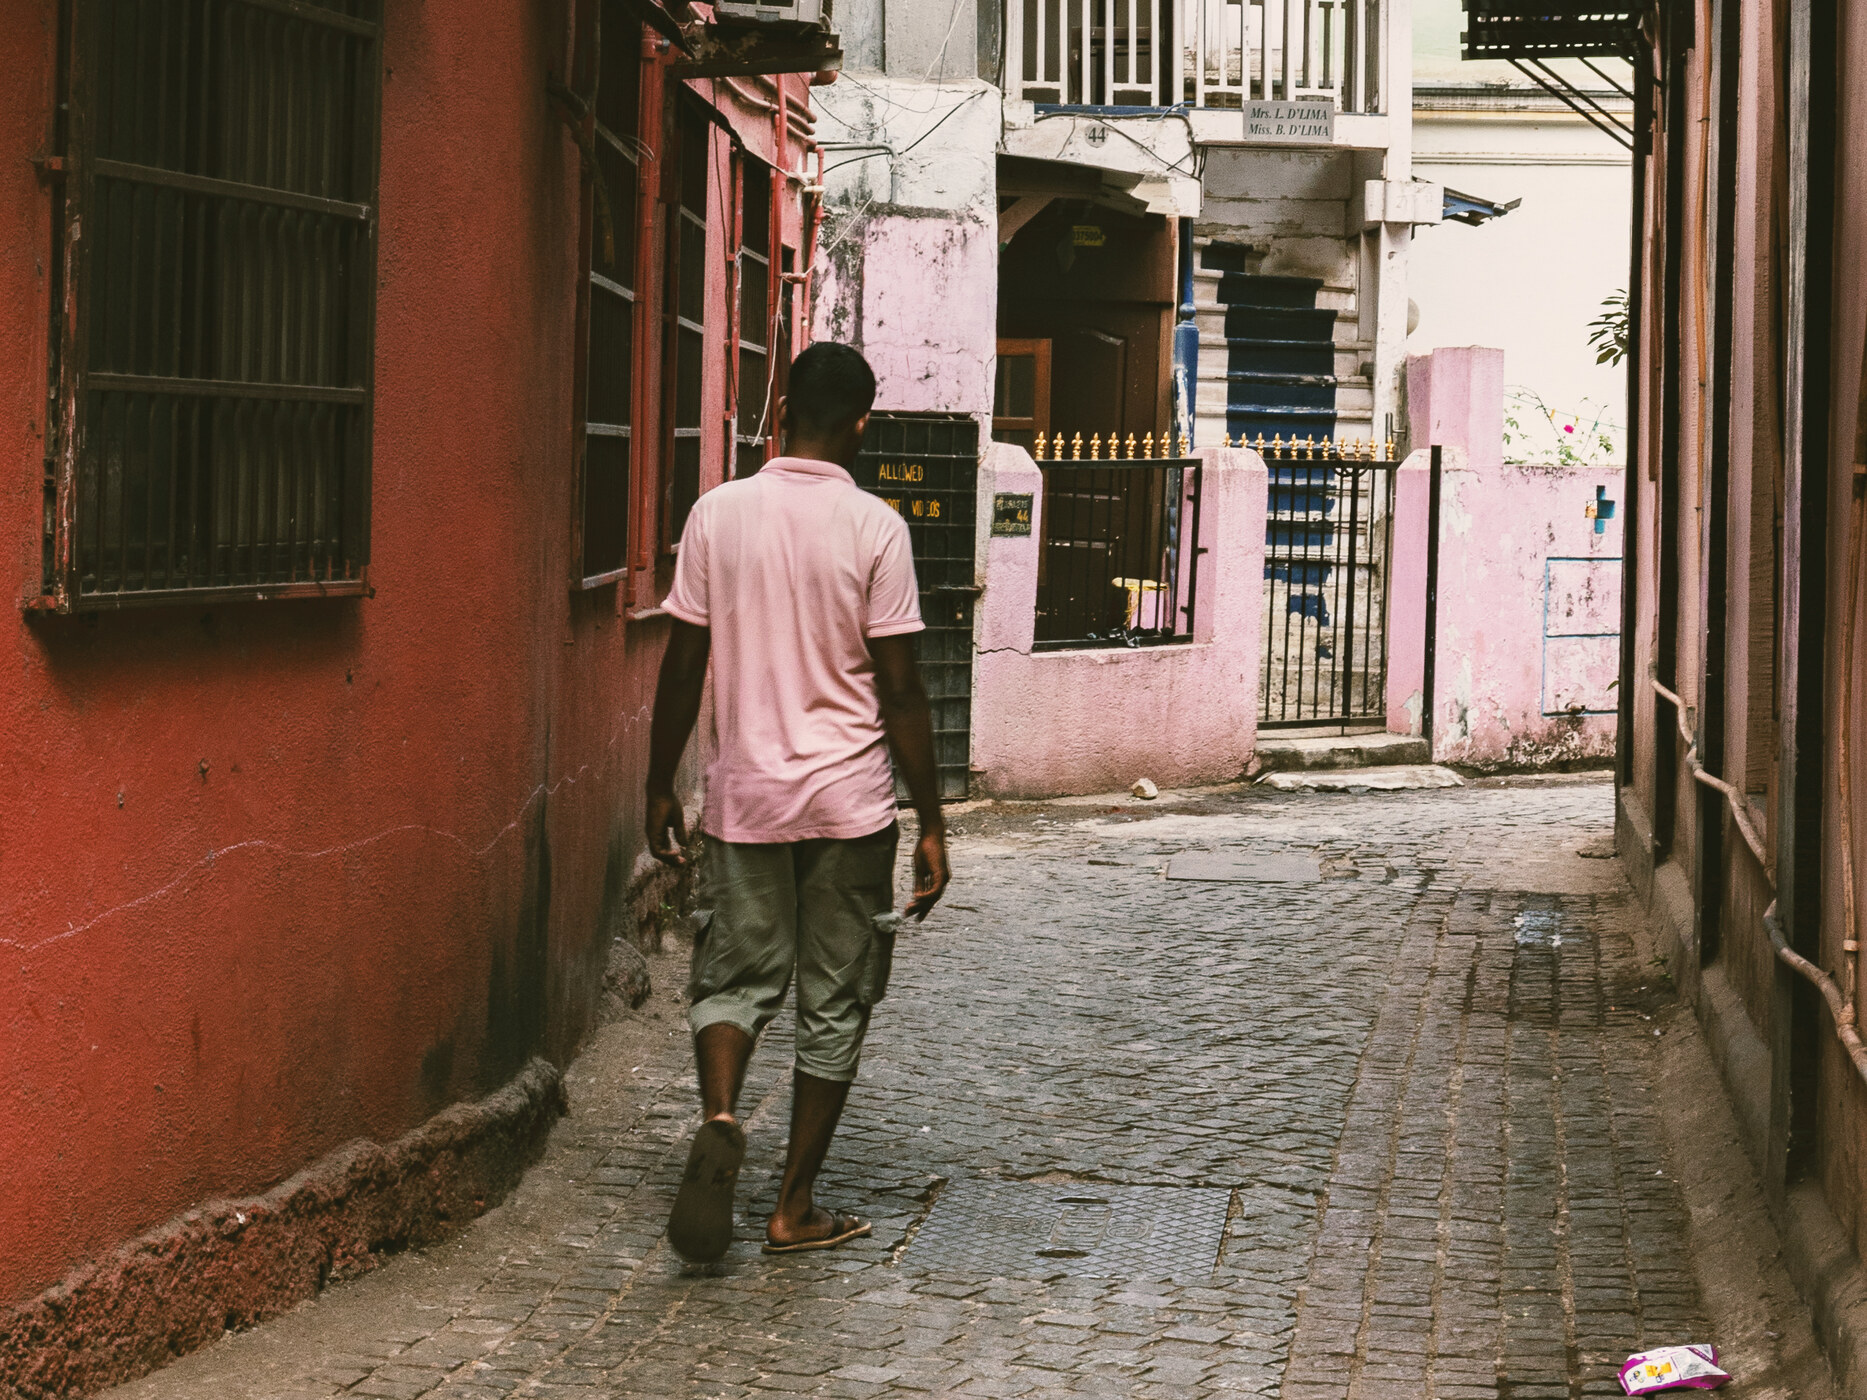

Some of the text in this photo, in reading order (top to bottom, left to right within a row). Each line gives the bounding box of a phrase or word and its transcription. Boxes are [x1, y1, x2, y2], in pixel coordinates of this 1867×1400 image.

[1250, 107, 1328, 120] Mrs. L. D'LIMA
[1088, 126, 1106, 143] 44
[1248, 123, 1329, 137] Miss. B. D'LIMA
[879, 463, 924, 481] ALLOWED
[1016, 509, 1029, 523] 44
